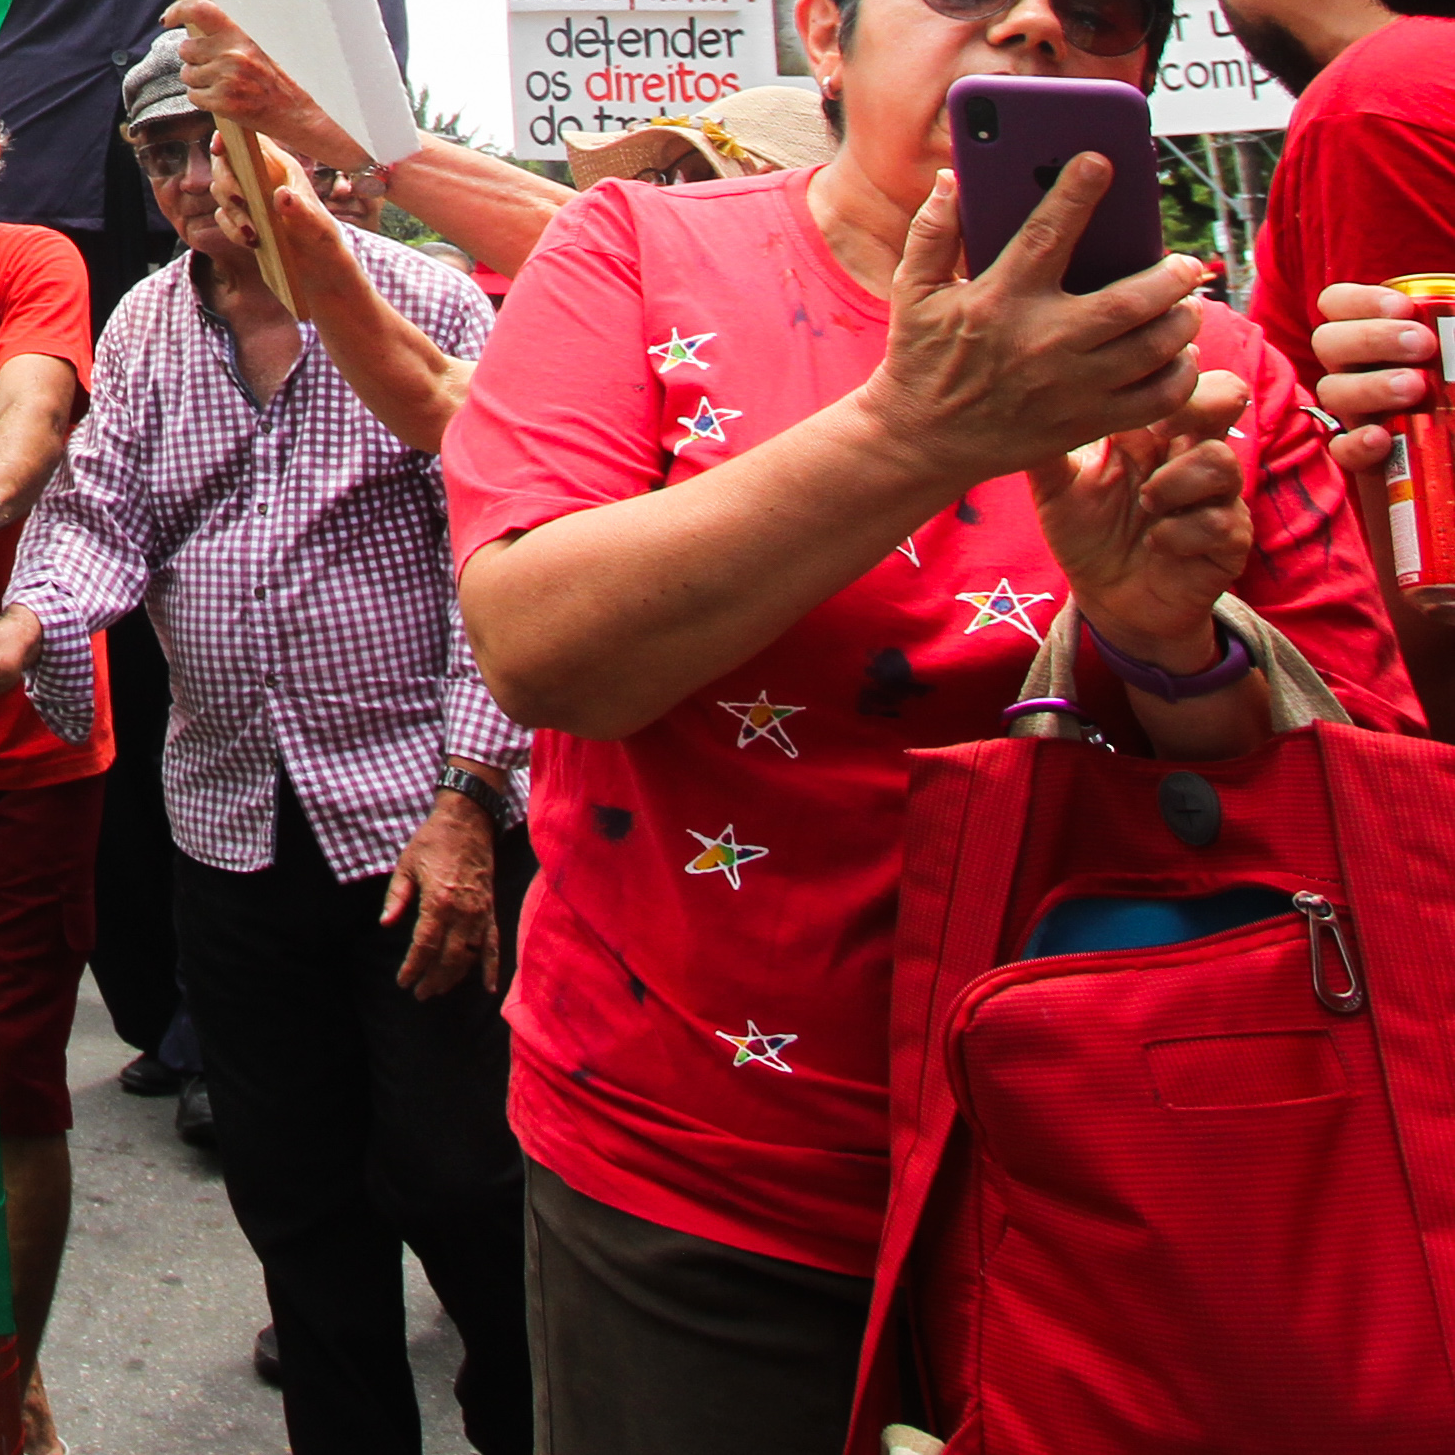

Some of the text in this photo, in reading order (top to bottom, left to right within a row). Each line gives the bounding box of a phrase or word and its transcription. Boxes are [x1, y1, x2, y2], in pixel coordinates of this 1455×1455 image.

[546, 16, 746, 66] defender
[525, 61, 741, 104] os direitos
